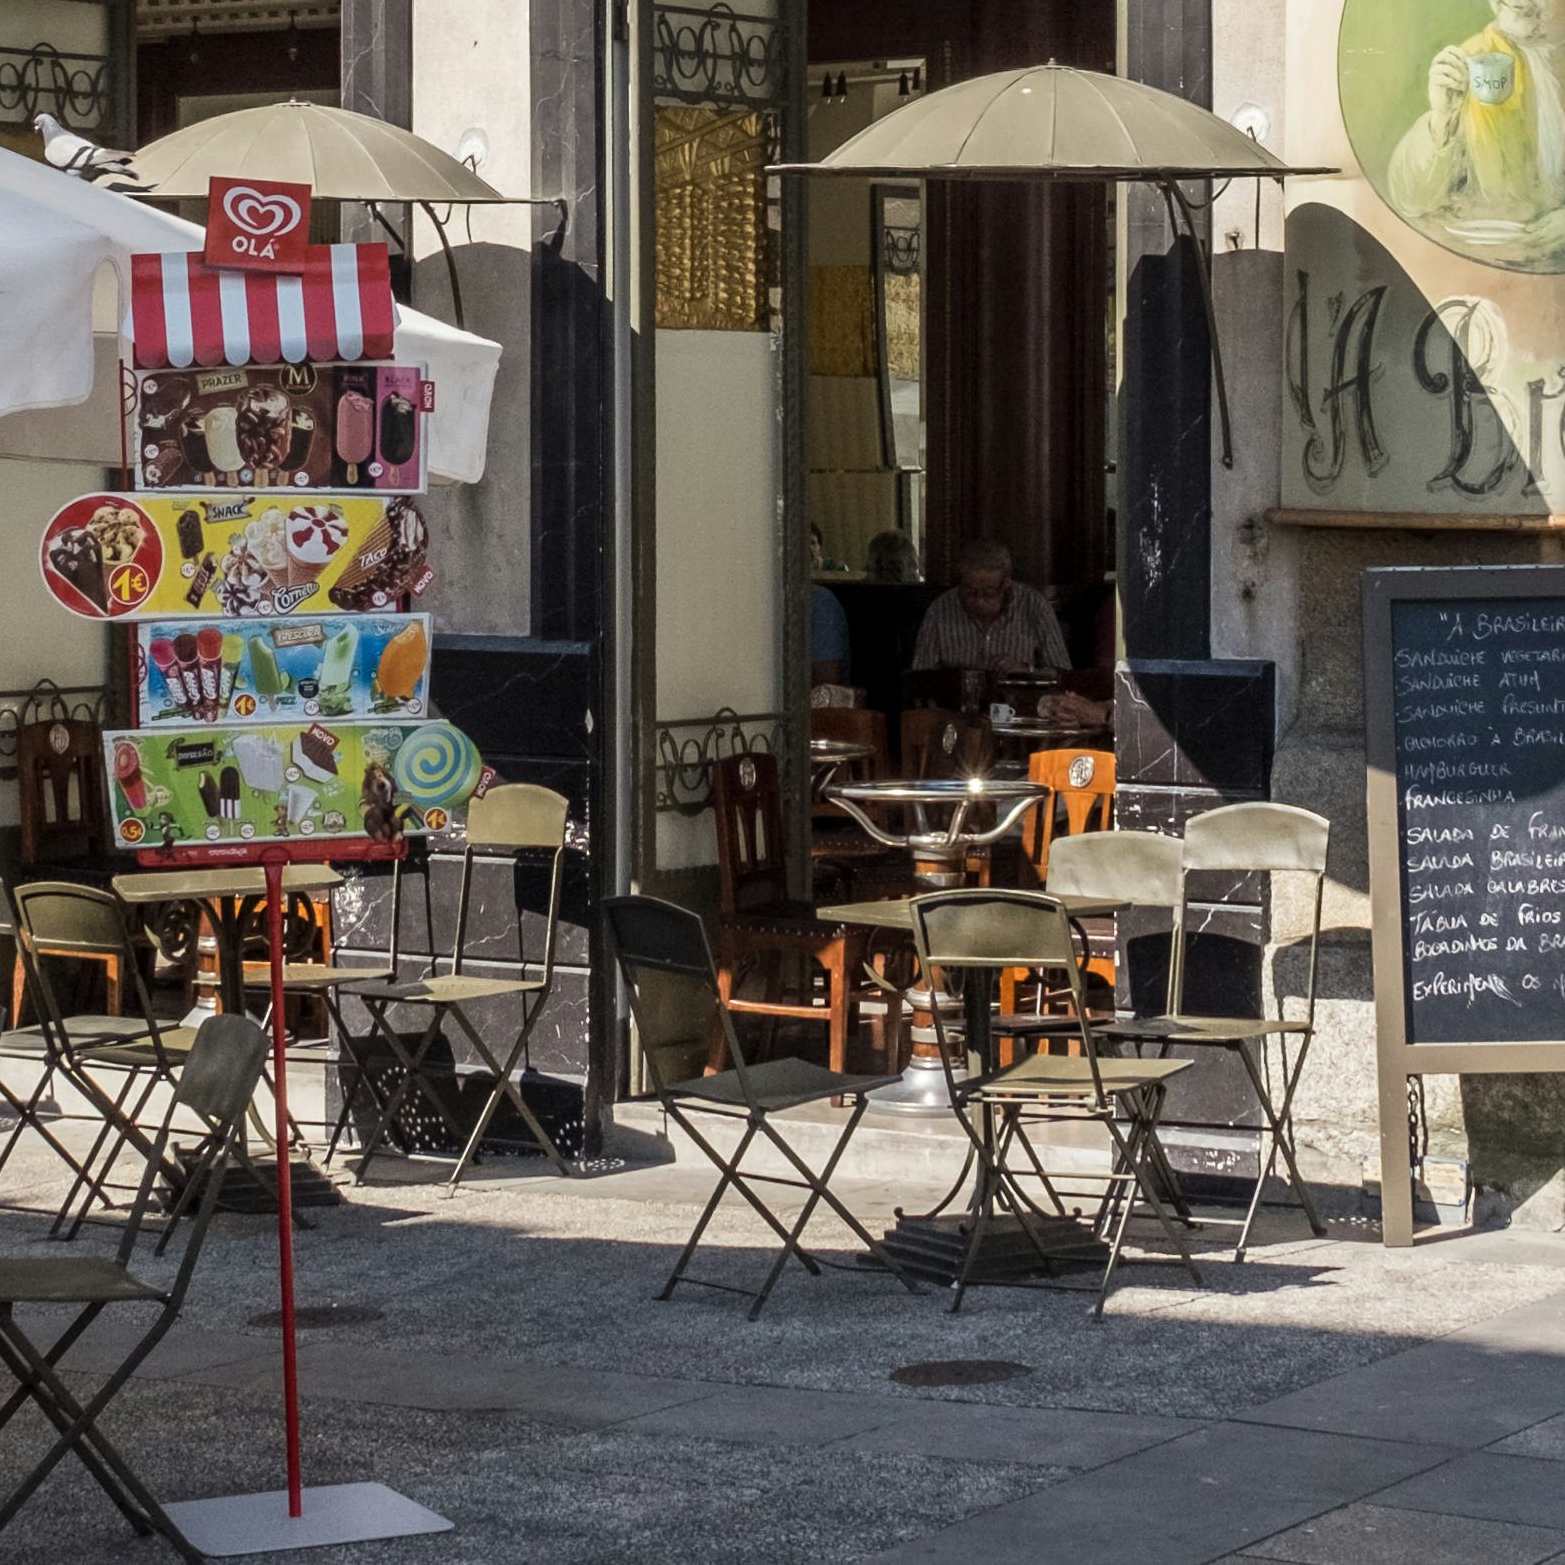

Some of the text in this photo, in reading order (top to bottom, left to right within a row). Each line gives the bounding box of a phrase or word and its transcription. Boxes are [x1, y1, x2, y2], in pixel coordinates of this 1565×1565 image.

[232, 236, 275, 260] OLÁ
[200, 373, 243, 389] PRAZER
[212, 504, 245, 520] SNACK
[359, 547, 389, 569] TACO
[112, 568, 148, 602] 1€
[1489, 824, 1511, 840] DE
[1478, 912, 1500, 927] DE
[1517, 902, 1562, 926] FRIOS
[1505, 935, 1527, 953] DA
